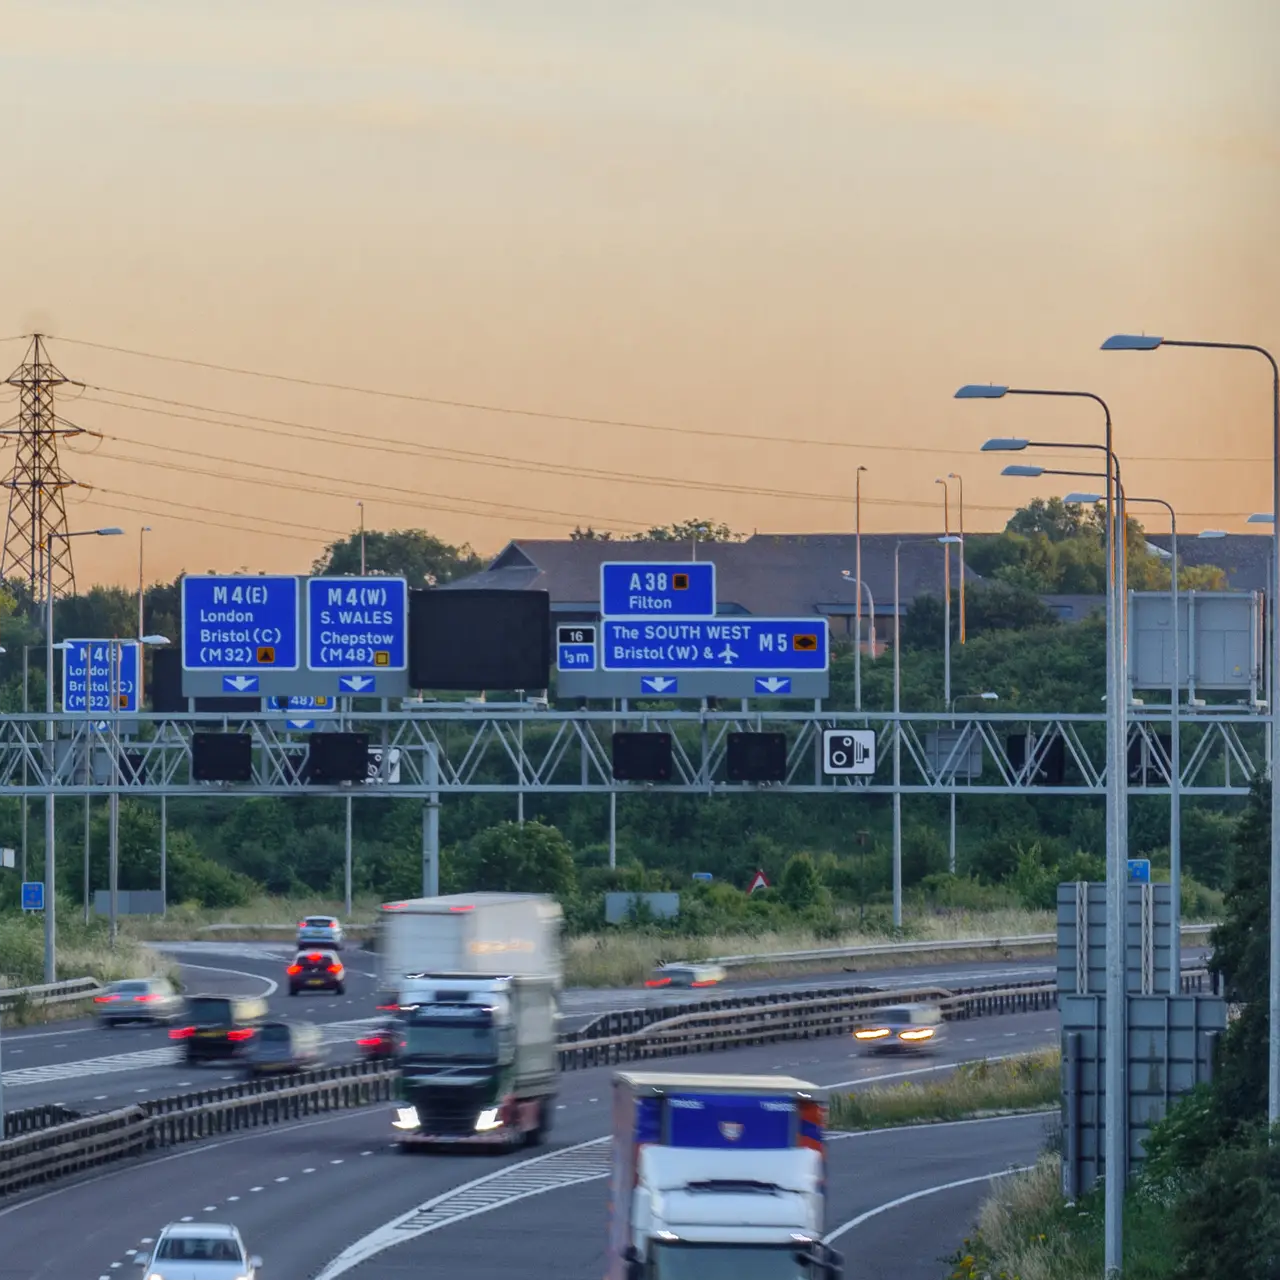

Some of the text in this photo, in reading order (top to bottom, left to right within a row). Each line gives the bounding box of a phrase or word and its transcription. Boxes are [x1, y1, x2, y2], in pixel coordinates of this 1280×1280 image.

[630, 596, 671, 609] Filton
[201, 609, 253, 622] London
[321, 611, 392, 624] S. WALES
[201, 628, 281, 643] Bristol (C)
[321, 631, 393, 646] Chepstow
[570, 631, 583, 642] 16
[613, 626, 751, 639] The SOUTH WEST
[614, 645, 713, 660] Bristol (W) &
[69, 680, 108, 691] Britol
[272, 696, 313, 707] (48)
